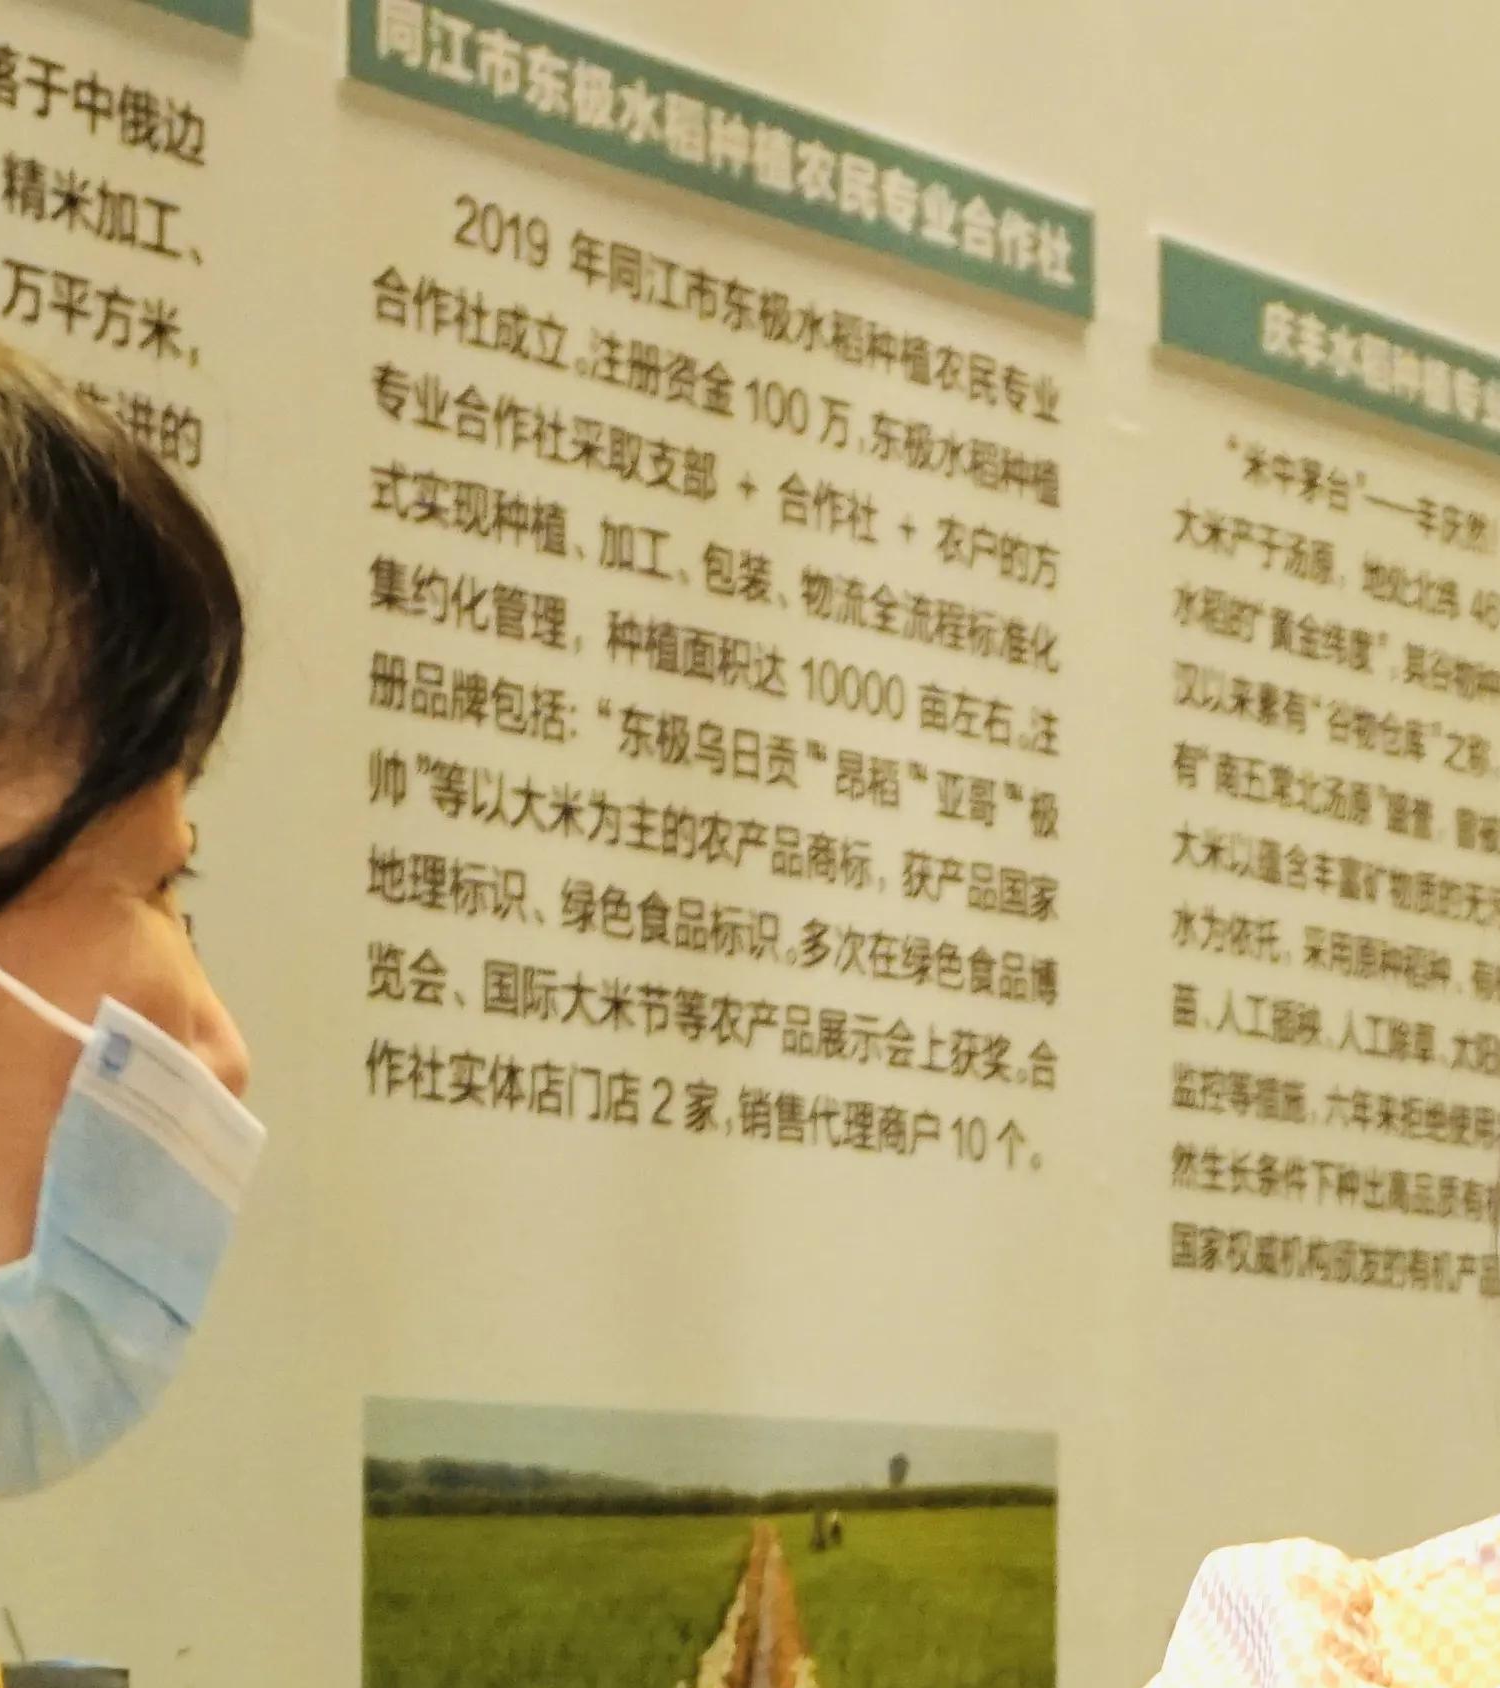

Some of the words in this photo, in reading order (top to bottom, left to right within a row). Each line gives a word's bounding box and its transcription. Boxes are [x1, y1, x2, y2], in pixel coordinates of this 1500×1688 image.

[377, 0, 1075, 286] 同江市东极水稻种植农民专业合作社
[455, 194, 551, 270] 2019
[75, 380, 202, 468] 进的
[745, 378, 809, 439] 100
[778, 472, 879, 546] 合作社
[802, 655, 905, 722] 10000
[652, 1076, 674, 1127] 2
[951, 1116, 988, 1163] 10
